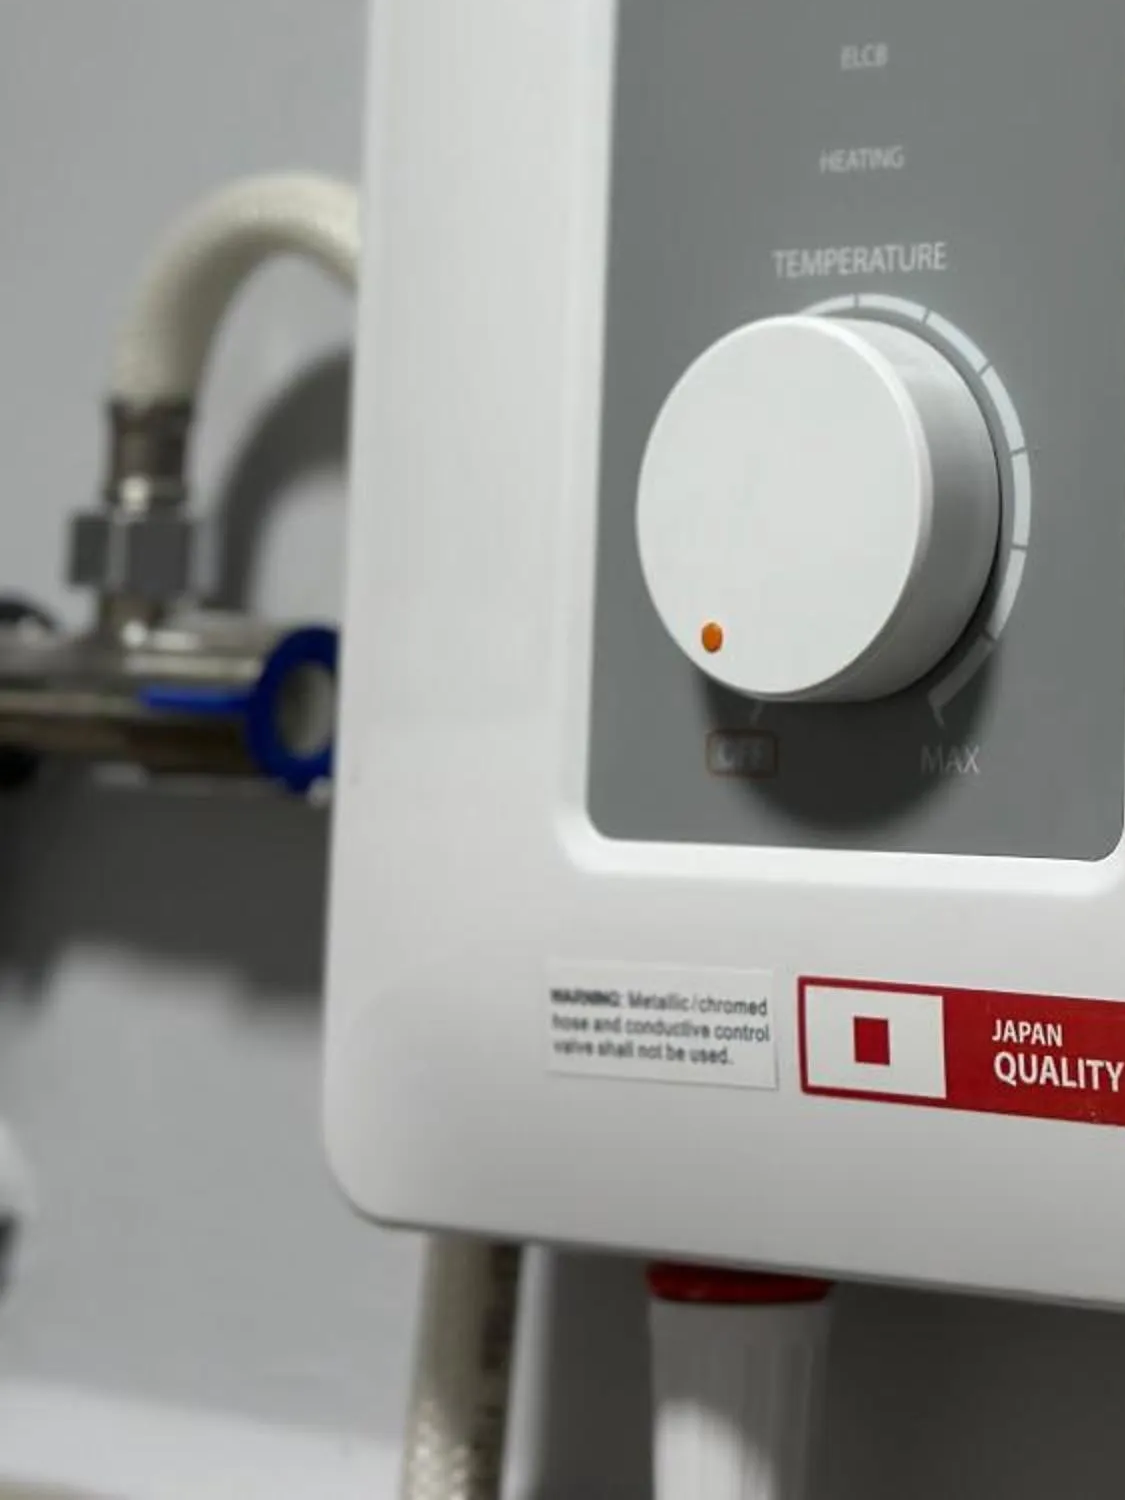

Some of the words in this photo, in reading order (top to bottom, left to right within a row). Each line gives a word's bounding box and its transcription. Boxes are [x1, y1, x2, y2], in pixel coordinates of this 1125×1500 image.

[840, 43, 888, 71] ELCB
[820, 146, 904, 173] HEATING
[772, 242, 947, 278] TEMPERATURE
[921, 744, 981, 775] MAX
[593, 1015, 621, 1032] and
[625, 1016, 709, 1037] conductive
[714, 1022, 770, 1041] control
[992, 1019, 1063, 1047] JAPAN
[665, 1044, 685, 1061] be
[993, 1050, 1125, 1092] QUALITY
